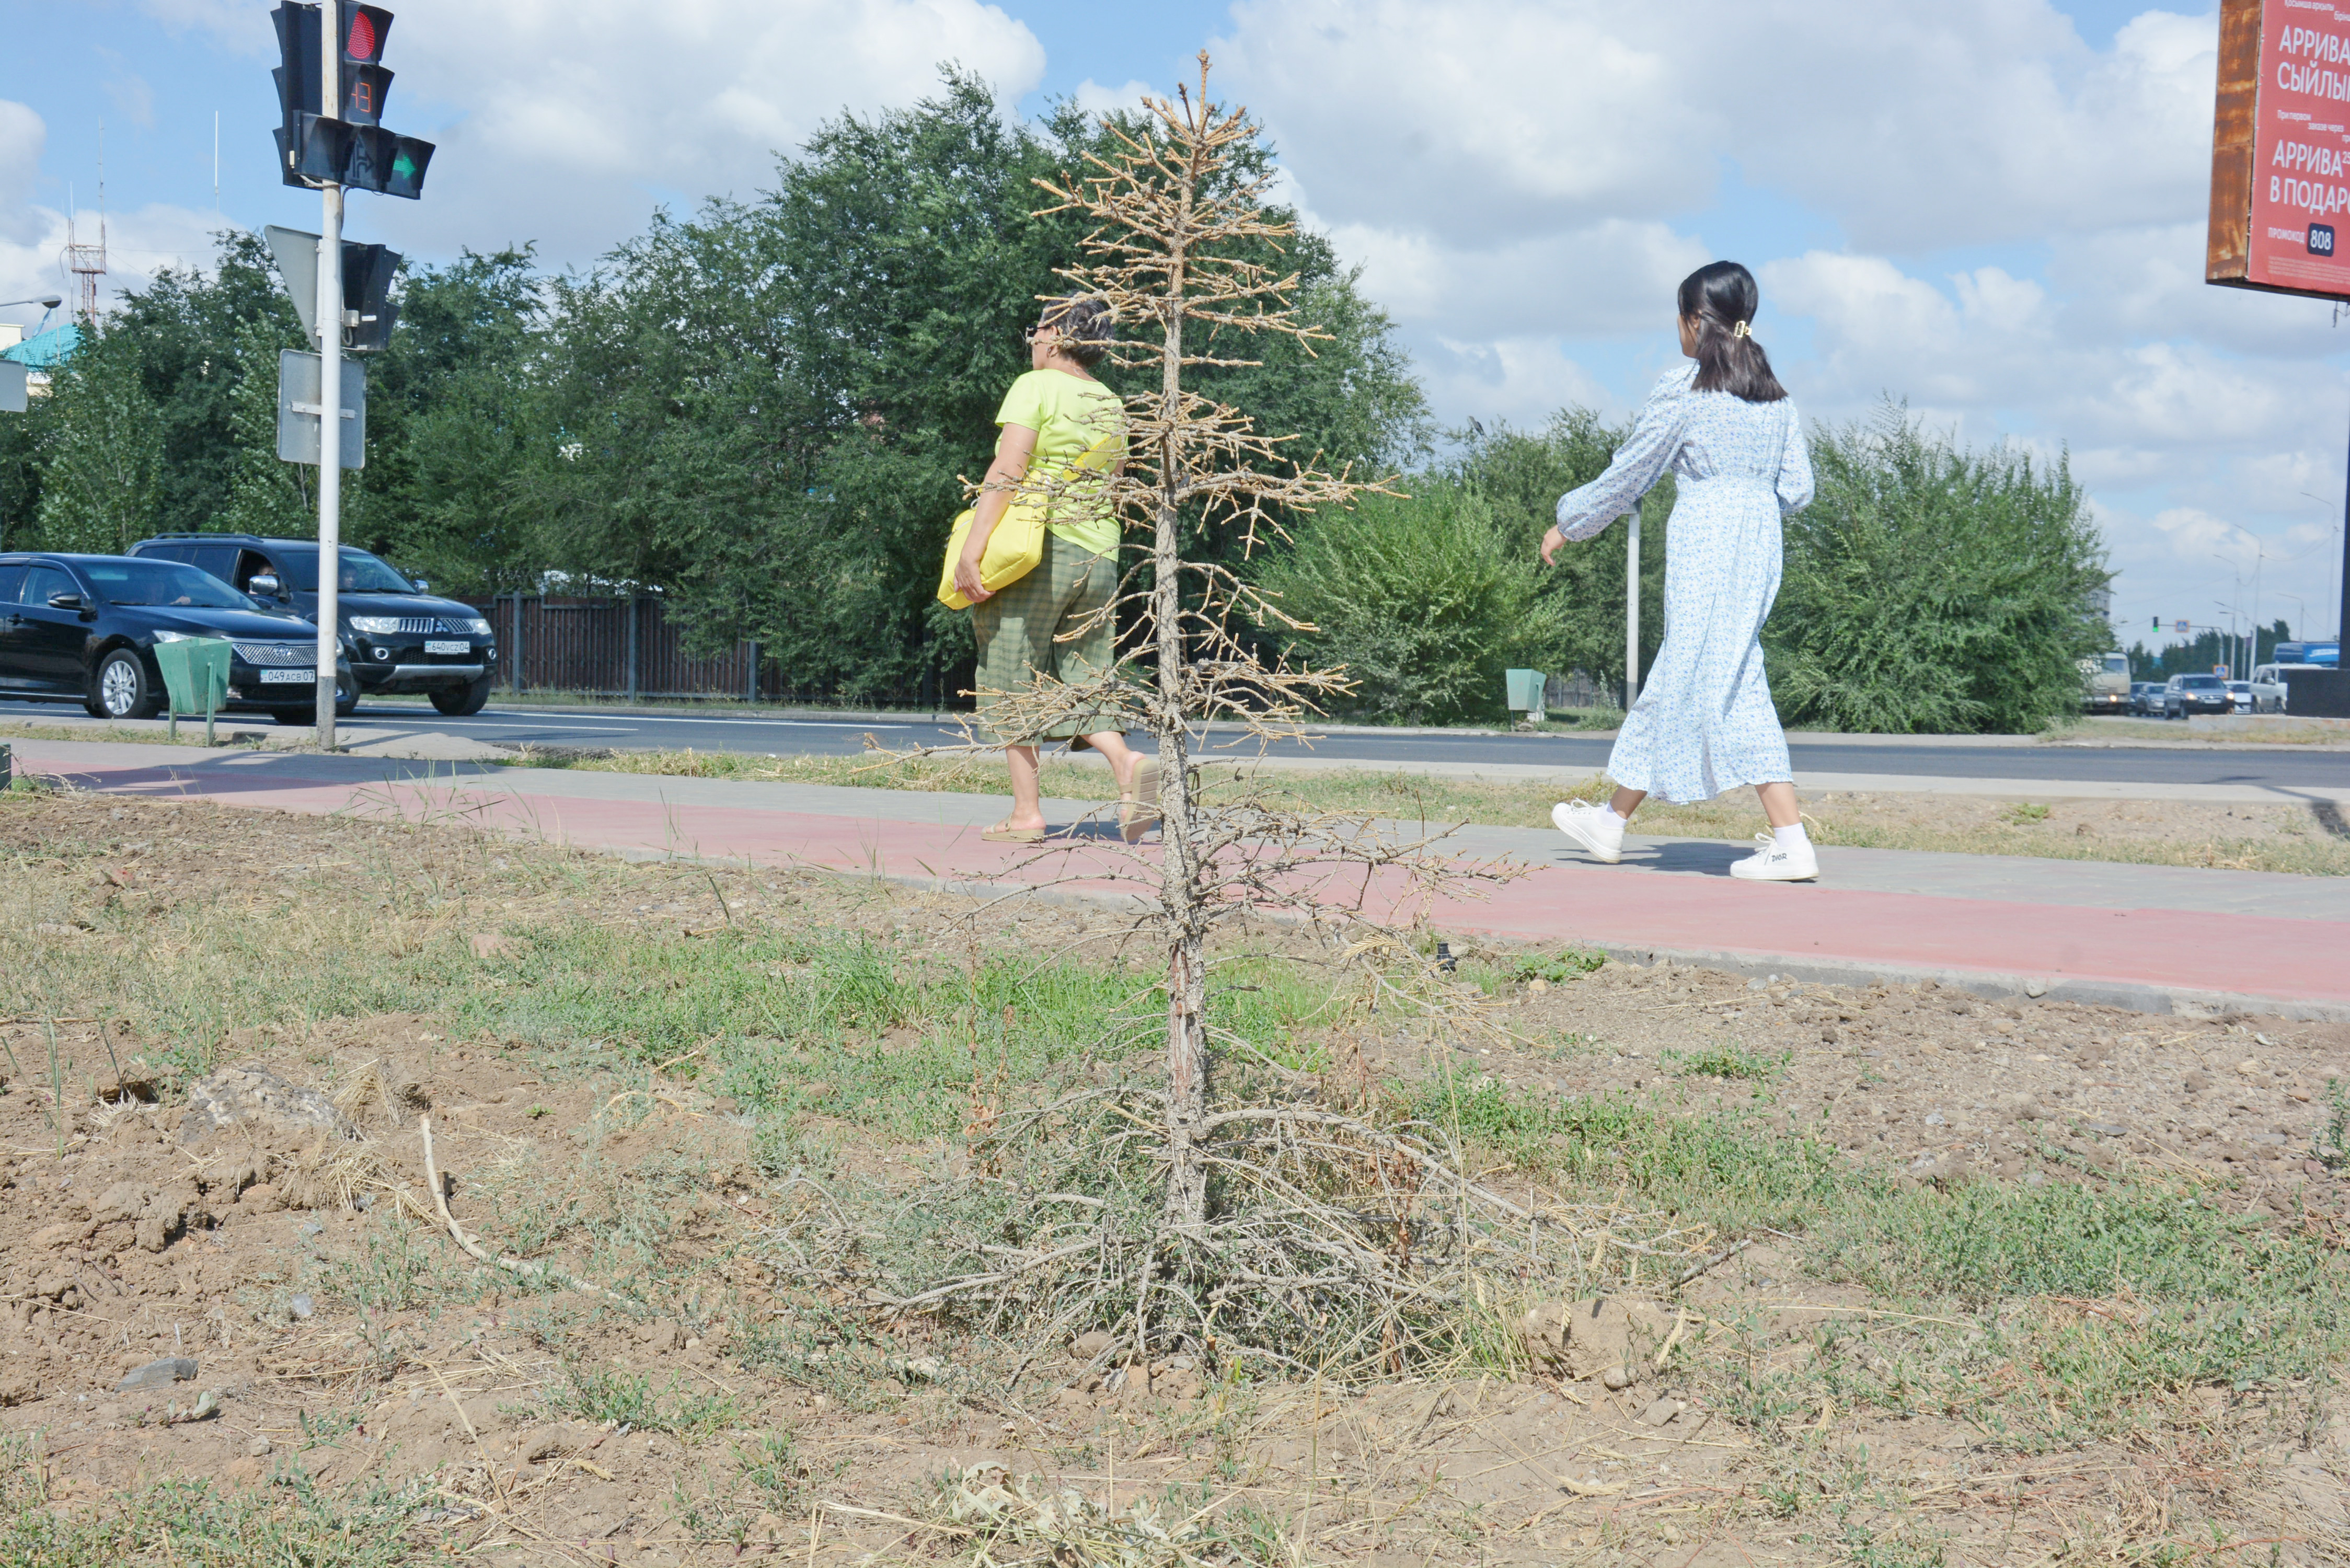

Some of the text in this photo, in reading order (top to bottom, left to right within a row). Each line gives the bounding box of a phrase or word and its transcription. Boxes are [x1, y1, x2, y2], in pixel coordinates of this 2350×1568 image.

[2277, 109, 2311, 122] При первом
[2308, 122, 2344, 134] заказе через
[2272, 139, 2343, 178] АРРИВА
[2270, 175, 2280, 203] В
[2267, 227, 2332, 250] ПРОМОКОД 808
[303, 671, 314, 681] 07
[1771, 852, 1788, 862] DIOR
